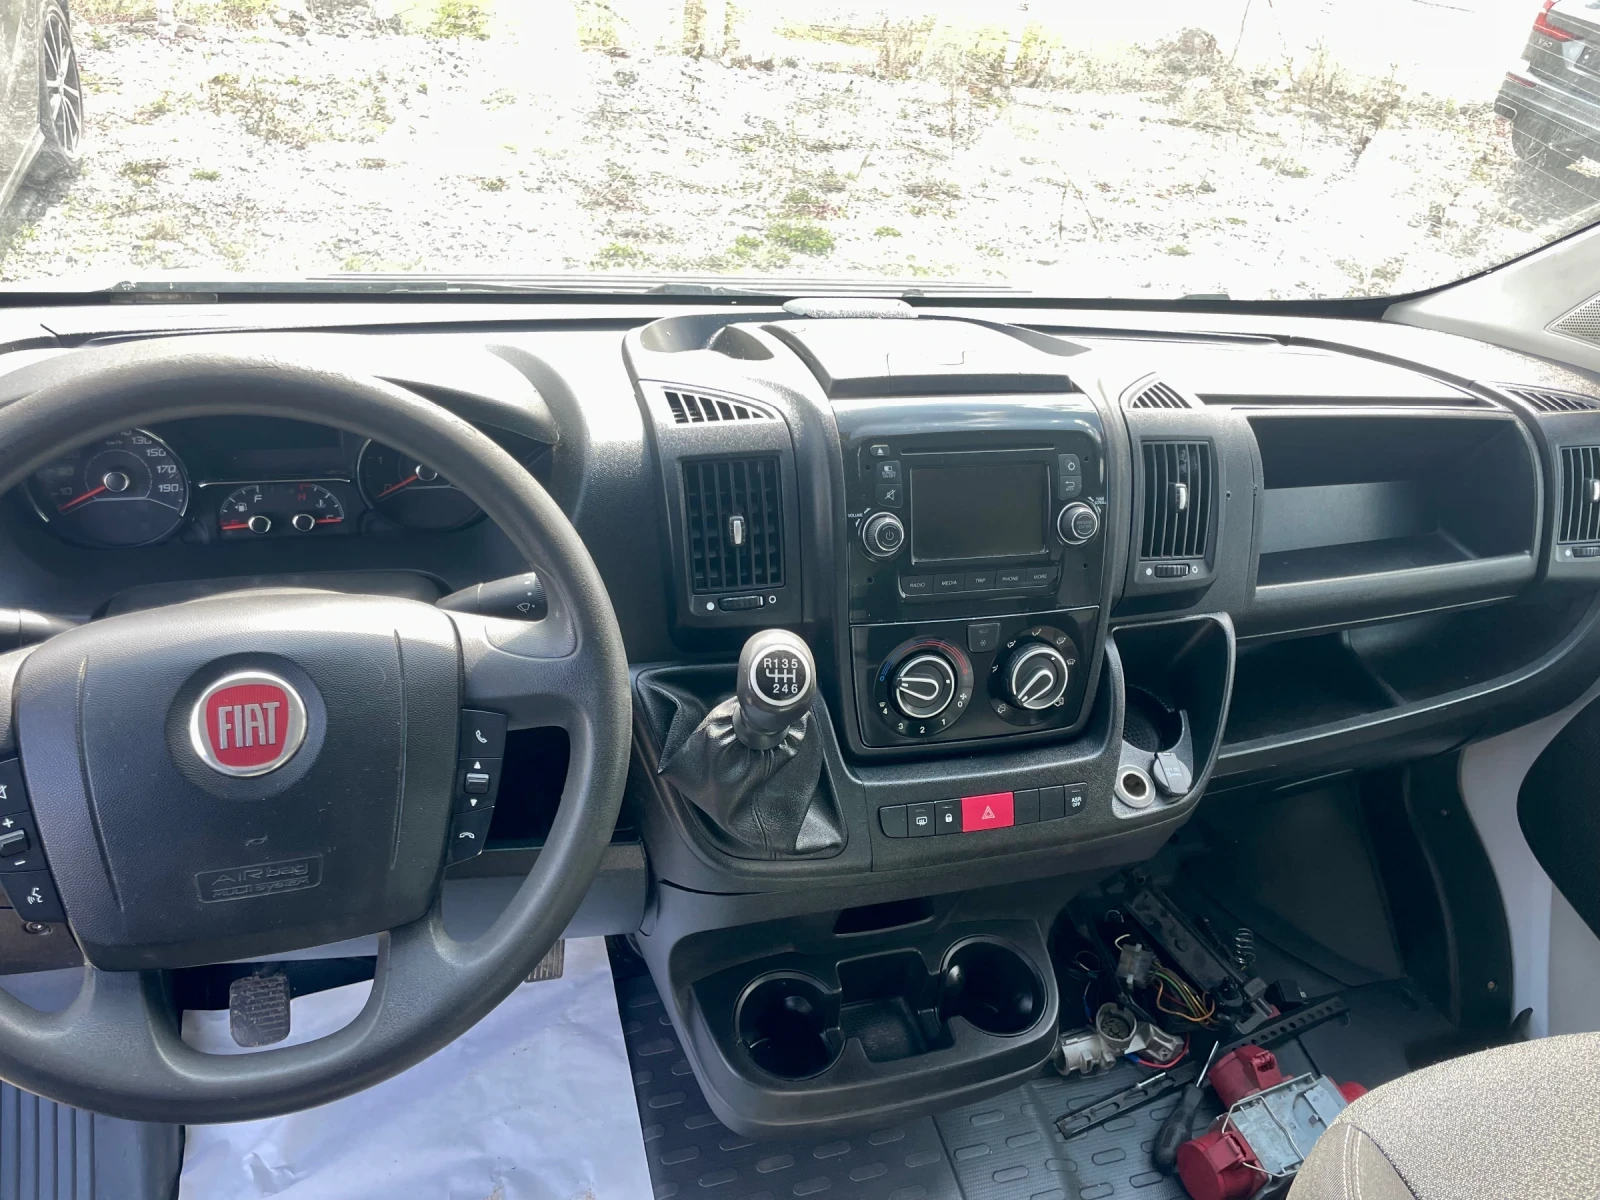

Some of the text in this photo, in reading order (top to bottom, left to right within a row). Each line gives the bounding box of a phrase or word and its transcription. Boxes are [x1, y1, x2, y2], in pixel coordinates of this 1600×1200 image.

[146, 448, 167, 457] 150
[156, 465, 176, 473] 170
[158, 484, 179, 492] 190
[254, 494, 262, 503] F
[763, 658, 798, 668] R 1 3 5
[773, 684, 798, 693] 2 4 6
[882, 707, 888, 715] 4
[218, 701, 280, 749] FIAT
[898, 722, 904, 730] 3
[941, 718, 946, 726] 1
[919, 726, 926, 734] 2
